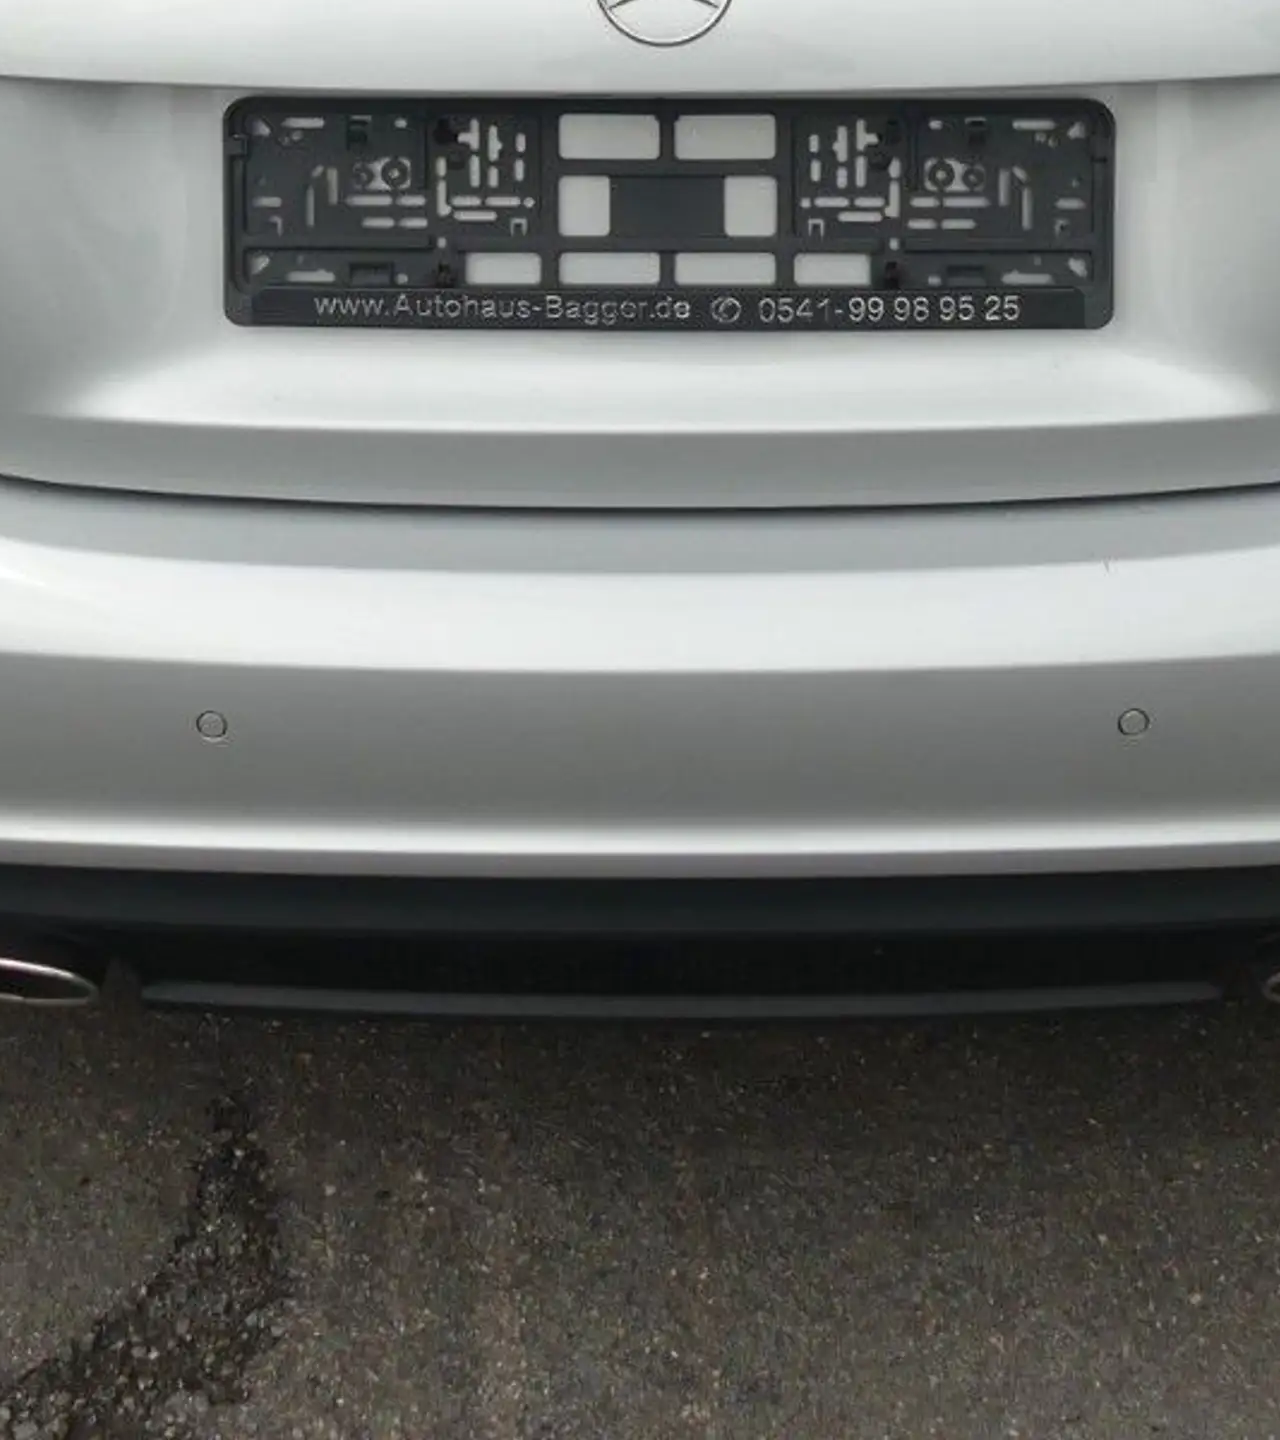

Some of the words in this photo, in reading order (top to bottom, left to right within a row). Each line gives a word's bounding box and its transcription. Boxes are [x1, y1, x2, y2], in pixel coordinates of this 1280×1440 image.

[314, 293, 692, 326] www.Autohaus-Bagger.de
[892, 296, 931, 322] 98
[938, 295, 975, 322] 95
[983, 294, 1020, 321] 25
